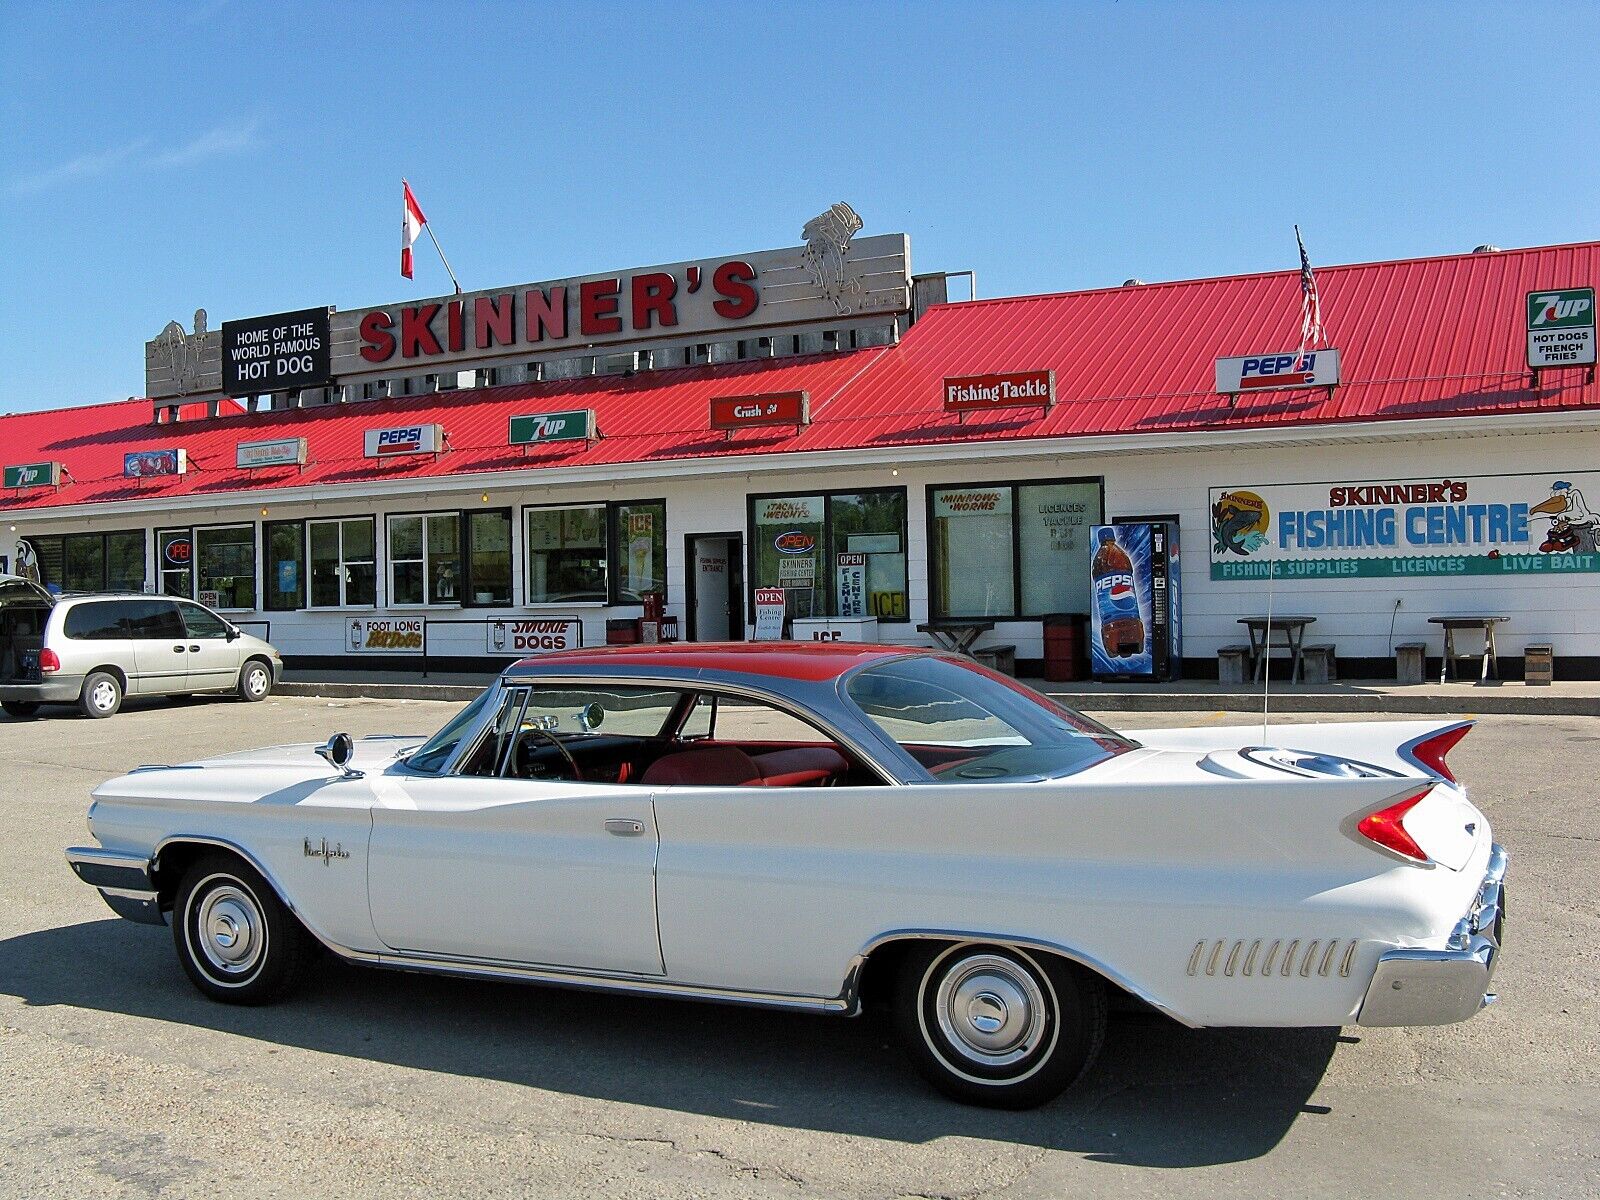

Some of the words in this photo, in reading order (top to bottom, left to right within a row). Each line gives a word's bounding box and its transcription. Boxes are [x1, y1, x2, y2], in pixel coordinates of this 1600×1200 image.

[359, 261, 758, 363] SKINNER'S
[1532, 295, 1590, 325] 7UP
[237, 329, 269, 346] HOME
[272, 326, 288, 341] OF
[291, 322, 314, 338] THE
[1533, 334, 1555, 343] HOT
[1558, 332, 1588, 341] DOGS
[231, 344, 270, 361] WORLD
[274, 337, 321, 356] FAMOUS
[1539, 343, 1583, 353] FRENCH
[1545, 352, 1577, 361] FRIES
[238, 360, 270, 381] HOT
[277, 355, 313, 376] DOG
[948, 384, 1000, 402] Fishing
[1001, 379, 1047, 398] Tackle
[734, 404, 762, 418] Crush
[379, 428, 421, 445] PEPSI
[531, 417, 566, 441] 7UP
[17, 468, 38, 486] 7UP
[943, 493, 1001, 503] MINNOWS
[1330, 480, 1467, 507] SKINNER'S
[770, 502, 808, 511] TACKLE
[953, 502, 995, 511] WORMS
[767, 511, 810, 519] WEIGHTS
[1278, 508, 1396, 549] FISHING
[1405, 503, 1529, 546] CENTRE
[778, 535, 815, 547] OPEN
[782, 559, 813, 569] SKINNERS
[840, 554, 863, 565] OPEN
[1392, 558, 1466, 573] LICENCES
[1502, 556, 1542, 570] LIVE
[1550, 554, 1592, 570] BAIT
[1223, 562, 1281, 577] FISHING
[1287, 561, 1359, 575] SUPPLIES
[1096, 574, 1134, 593] PEPSI
[199, 592, 217, 601] OPEN
[757, 592, 783, 602] OPEN
[852, 571, 862, 614] CENTRE
[367, 622, 391, 632] FOOT
[395, 621, 421, 632] LONG
[662, 623, 678, 639] SUN
[514, 635, 566, 650] DOGS
